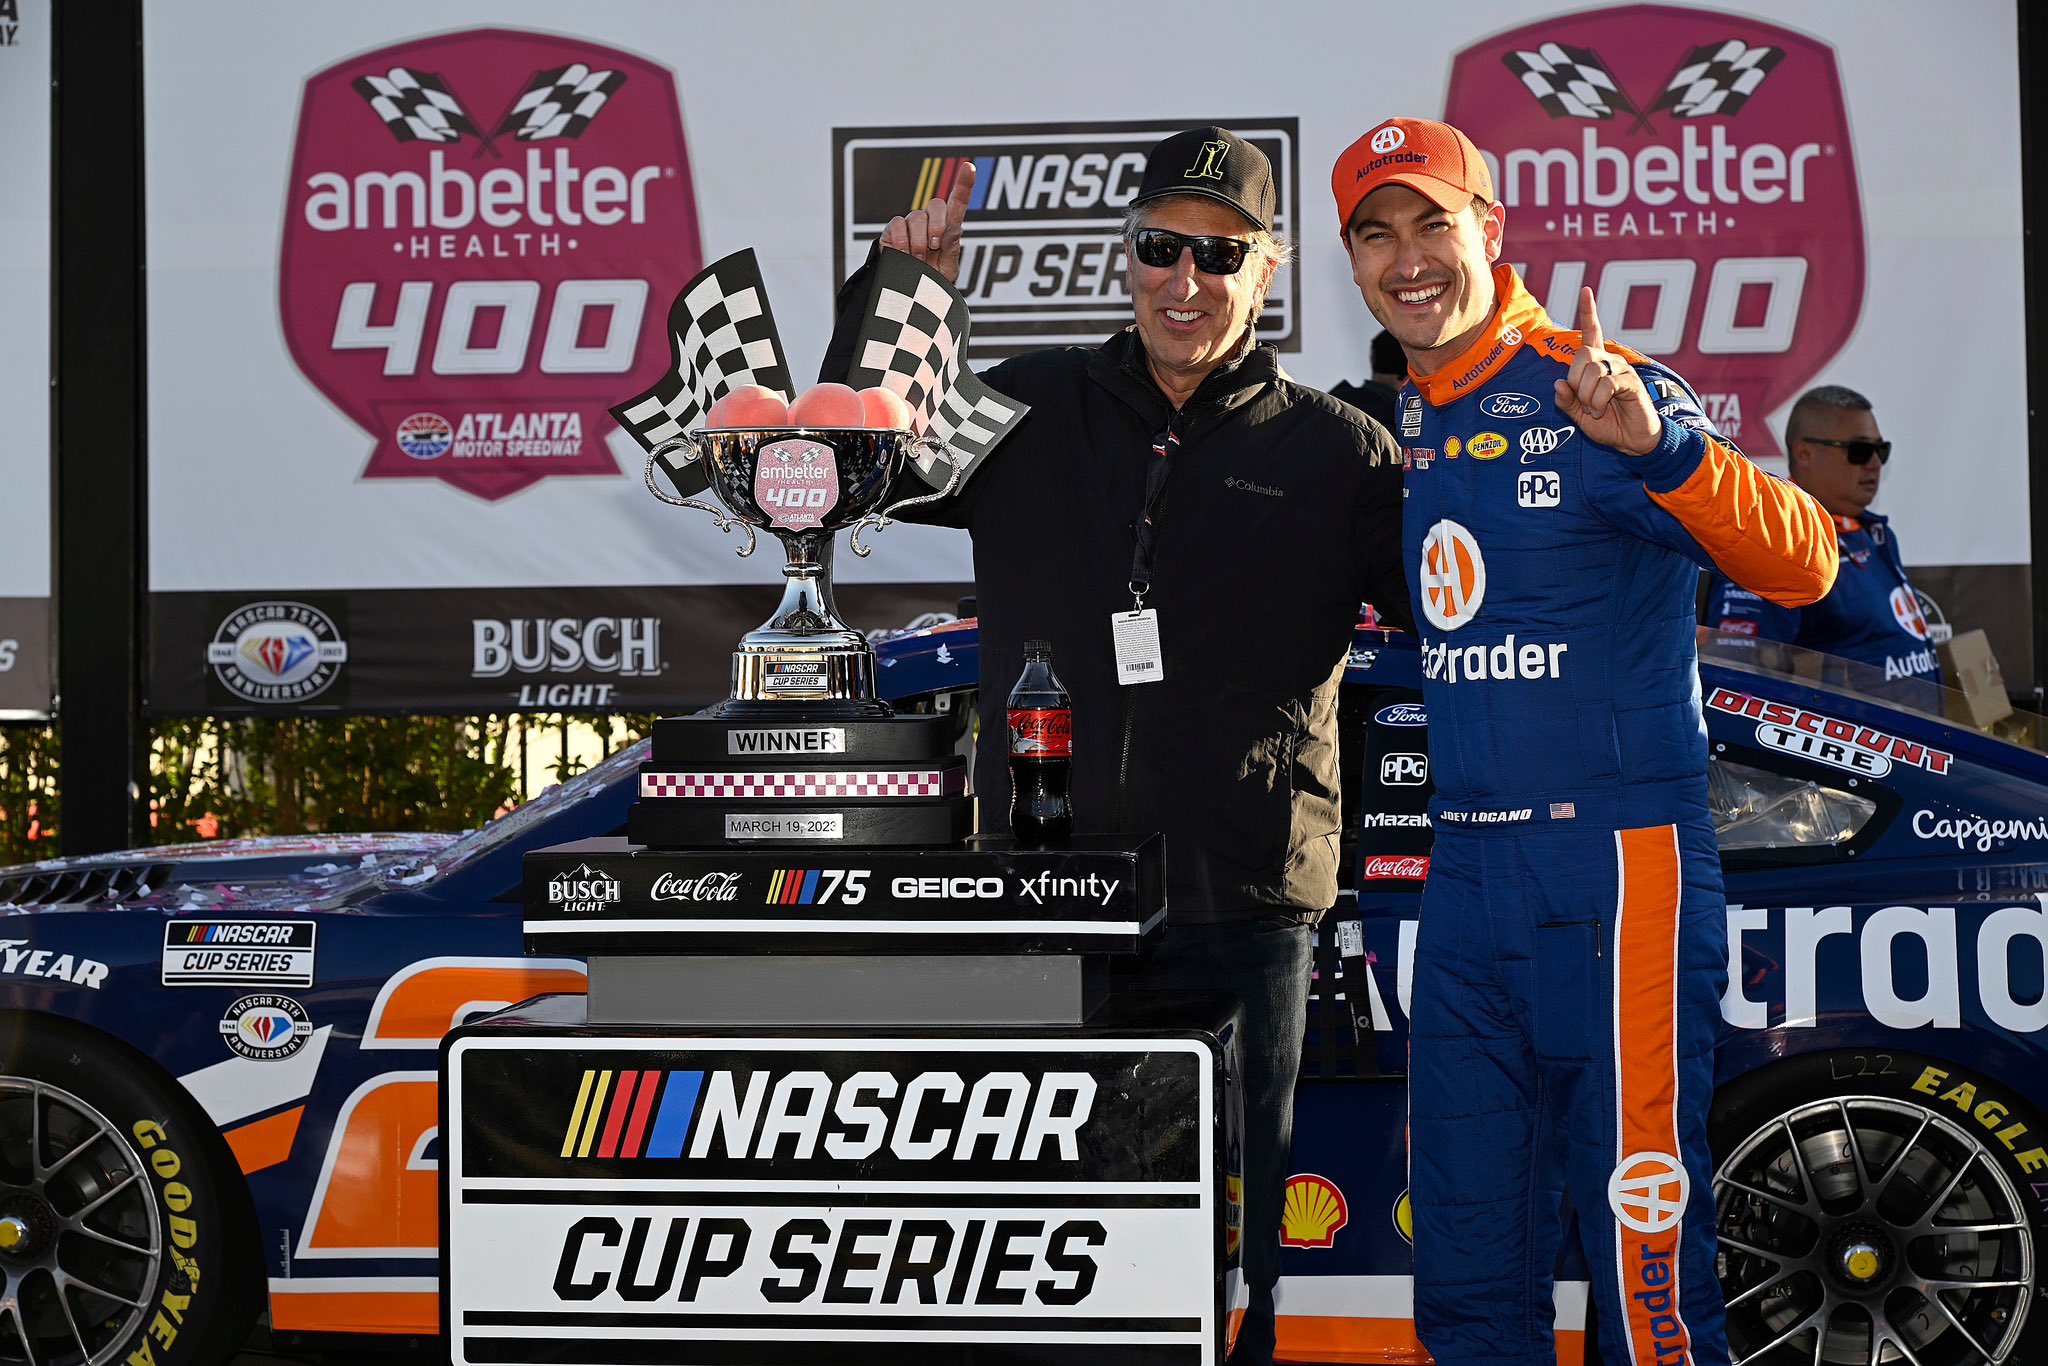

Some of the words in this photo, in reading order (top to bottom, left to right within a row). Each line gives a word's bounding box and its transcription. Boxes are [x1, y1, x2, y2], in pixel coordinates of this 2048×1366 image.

[1356, 151, 1428, 182] Autotrader
[304, 148, 661, 231] ambetter
[1563, 212, 1720, 237] HEALTH
[409, 233, 561, 258] HEALTH
[331, 279, 650, 376] 400
[1452, 341, 1505, 391] Autotrader
[1491, 395, 1530, 414] Ford
[455, 412, 583, 441] ATLANTA
[452, 440, 503, 458] MOTOR
[506, 440, 581, 457] SPEEDWAY
[1473, 439, 1502, 453] PENNZOIL
[1524, 428, 1554, 453] AAA
[760, 464, 829, 479] ambetter
[765, 488, 828, 508] 400
[1236, 479, 1284, 497] Columbia
[1519, 474, 1559, 504] PPG
[227, 606, 286, 637] NASCAR
[290, 607, 328, 636] 75TH
[471, 616, 662, 678] BUSCH
[784, 664, 819, 673] NASCAR
[224, 664, 330, 699] ANNIVERSARY
[773, 677, 789, 686] CUP
[789, 677, 819, 685] SERIES
[518, 684, 613, 706] LIGHT
[735, 731, 836, 752] WINNER
[1710, 689, 1953, 774] DISCOUNT
[1770, 728, 1874, 771] TIRE
[1383, 756, 1425, 781] PPG
[731, 821, 781, 832] MARCH
[786, 820, 804, 834] 19,
[808, 820, 836, 832] 2023
[1440, 810, 1468, 822] JOEY
[1471, 808, 1532, 823] LOGANO
[1365, 857, 1428, 877] Coca-Cola
[548, 880, 620, 903] BUSCH
[651, 872, 743, 902] Coca-Cola
[817, 870, 871, 905] 75
[891, 877, 1003, 898] GEICO
[1019, 870, 1120, 905] xfinity
[563, 902, 604, 912] LIGHT
[212, 925, 293, 943] NASCAR
[183, 953, 223, 970] CUP
[224, 954, 293, 971] SERIES
[232, 997, 273, 1016] NASCAR
[275, 998, 301, 1017] 75TH
[229, 1035, 302, 1059] ANNIVERSARY
[1829, 1054, 1898, 1080] L22
[688, 1071, 1097, 1160] NASCAR
[1911, 1066, 2048, 1175] EAGLE
[552, 1216, 752, 1302] CUP
[759, 1217, 1108, 1305] SERIES
